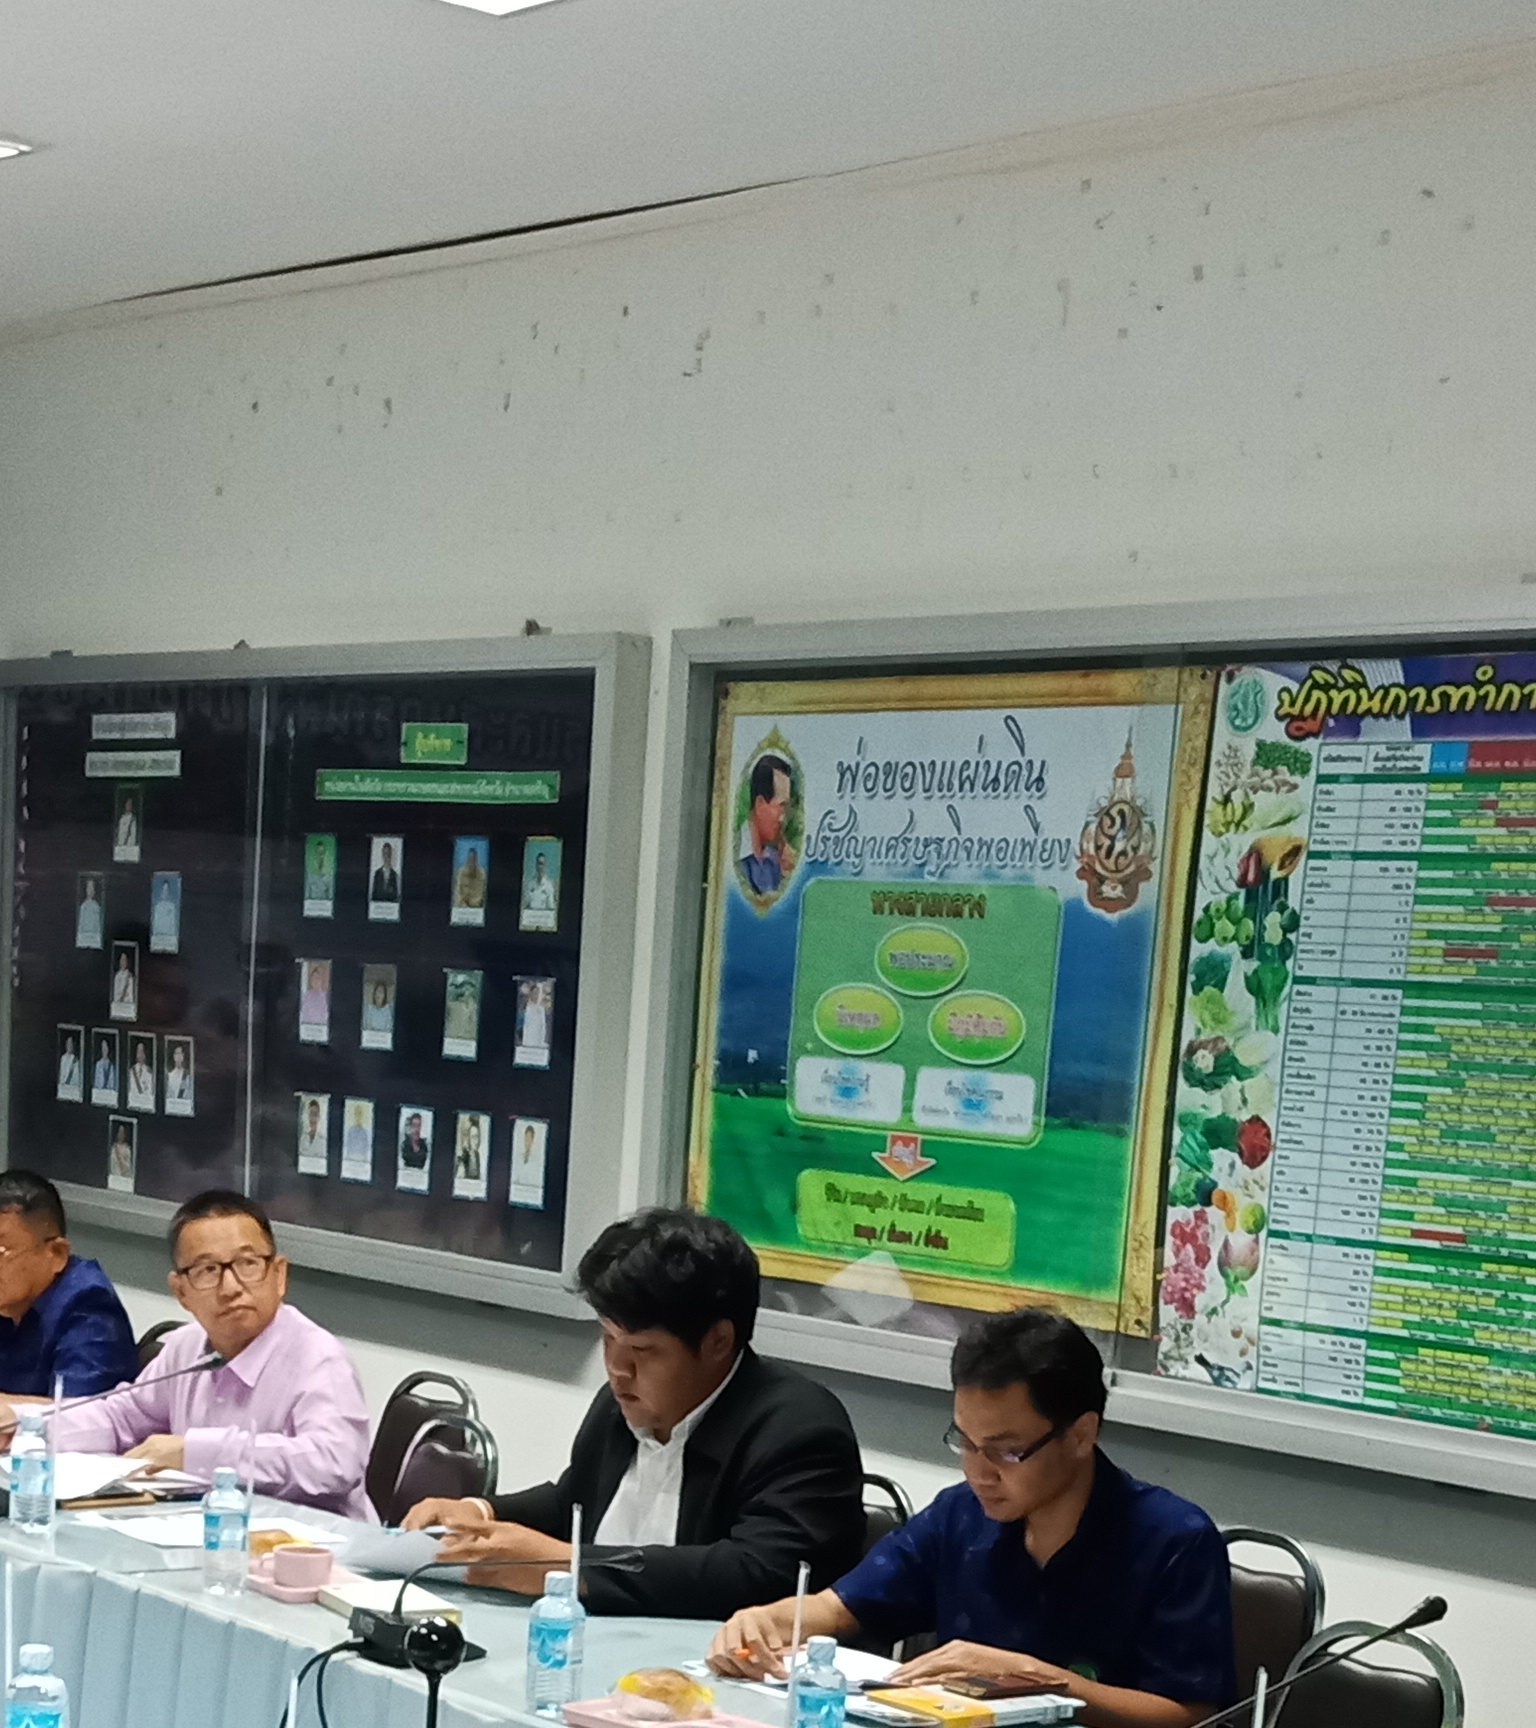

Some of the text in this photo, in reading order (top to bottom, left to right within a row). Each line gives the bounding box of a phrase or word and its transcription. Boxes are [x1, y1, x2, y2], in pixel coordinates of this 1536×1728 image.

[835, 715, 1049, 797] พ่อของแผ่นดิน
[805, 804, 1073, 879] ปรัชญาเศรษฐกิจพอเพียง
